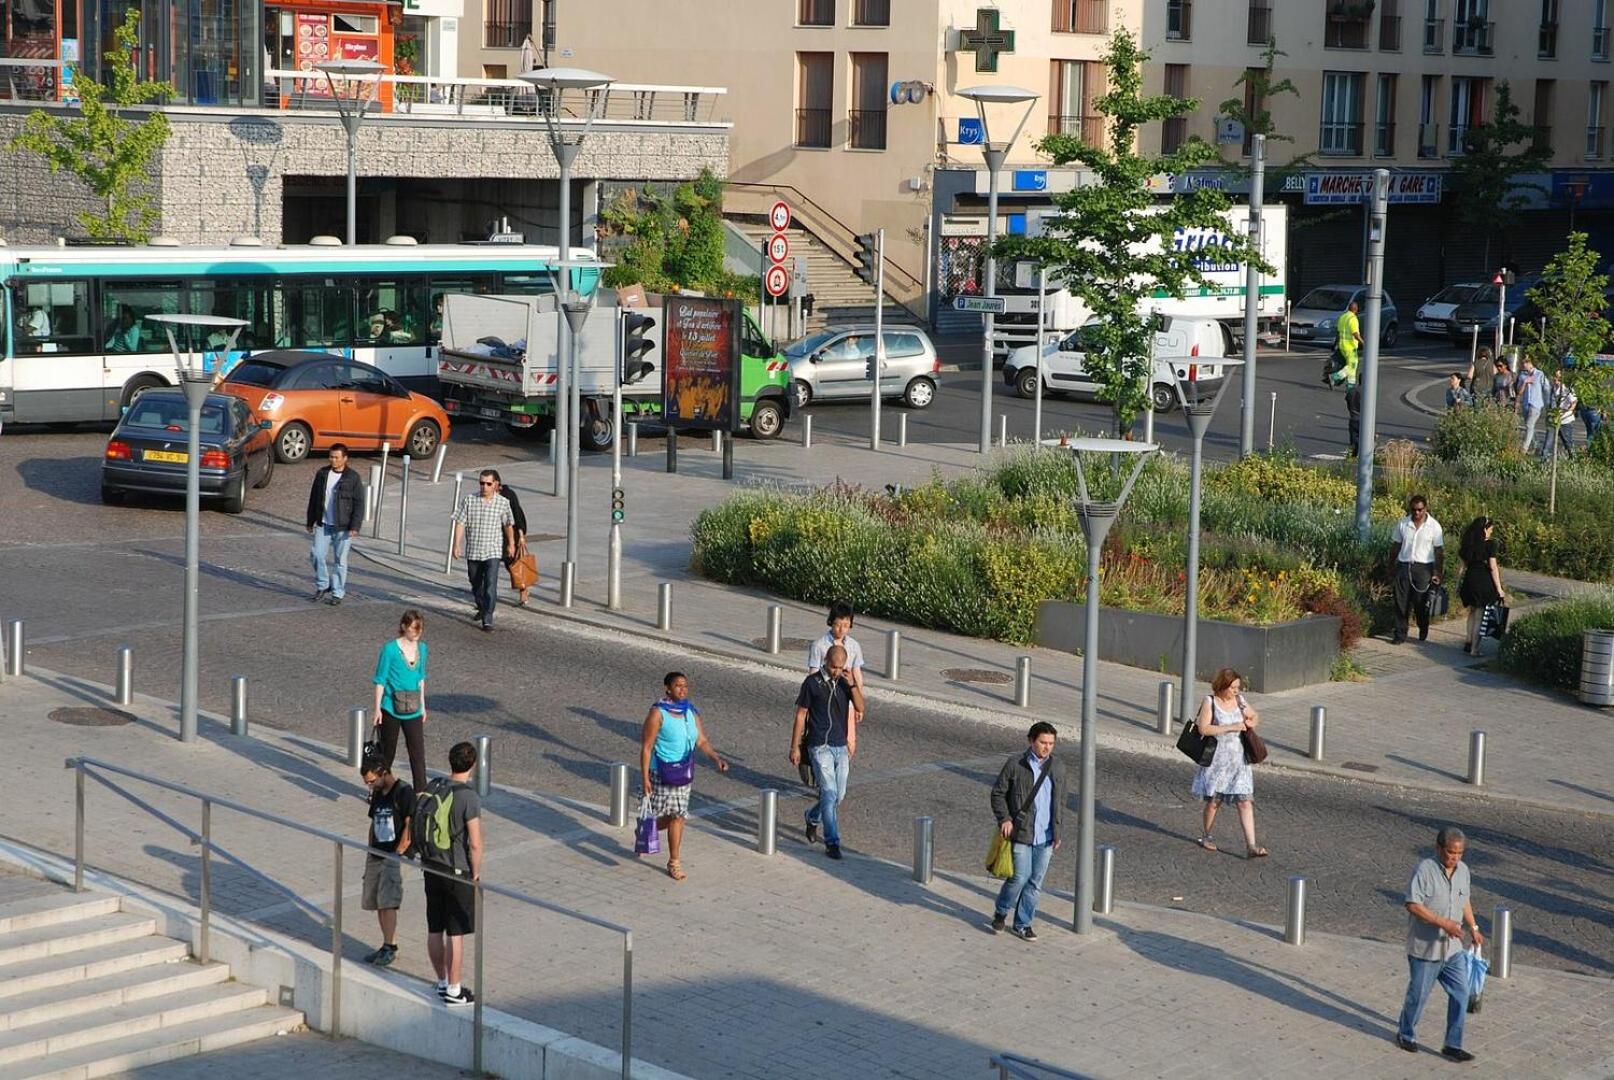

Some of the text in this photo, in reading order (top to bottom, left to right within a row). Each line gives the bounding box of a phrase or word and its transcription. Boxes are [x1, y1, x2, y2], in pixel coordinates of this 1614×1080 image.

[960, 126, 978, 137] Krys
[1399, 176, 1427, 193] GARE
[967, 299, 981, 309] Jean
